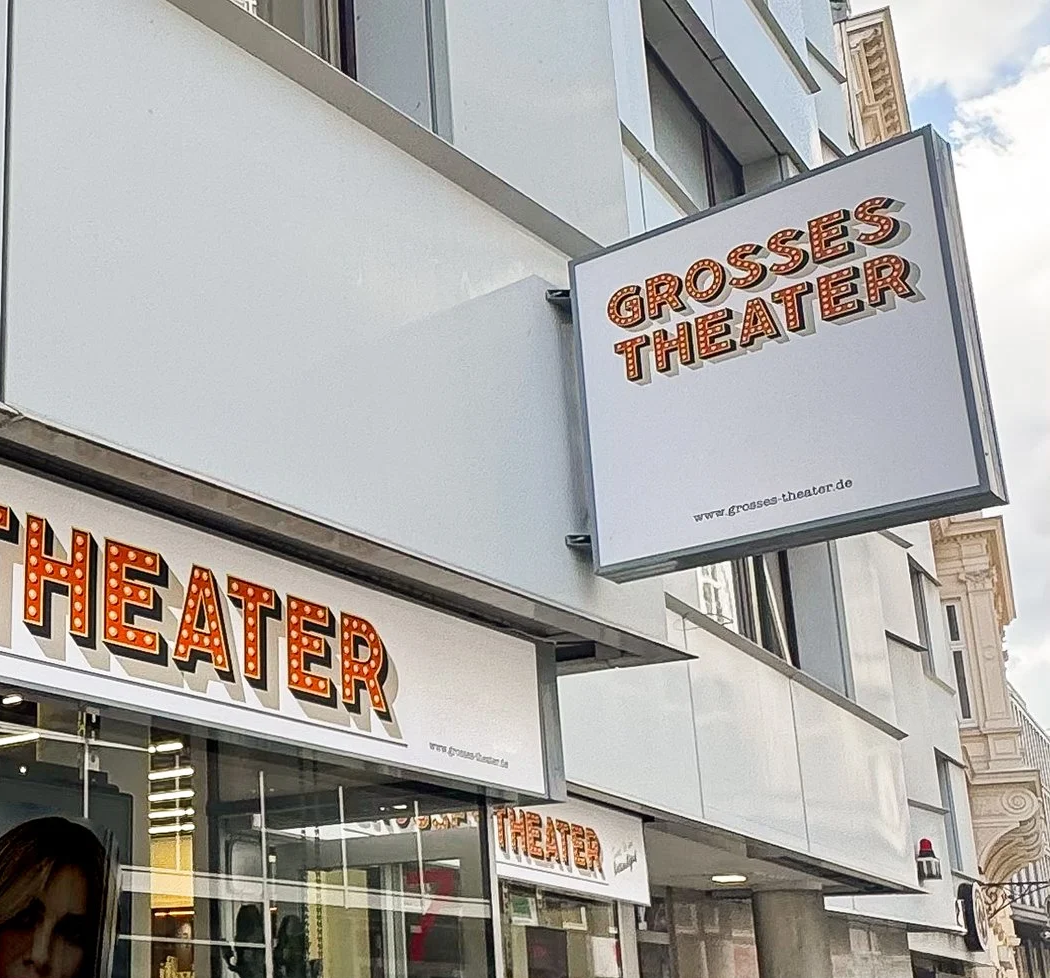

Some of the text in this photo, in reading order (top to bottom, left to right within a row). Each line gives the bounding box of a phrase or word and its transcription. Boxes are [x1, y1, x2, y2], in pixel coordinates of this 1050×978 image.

[606, 197, 900, 328] GROSSES
[613, 254, 917, 382] THEATER
[692, 478, 853, 523] www.grosses-theater.de
[492, 806, 603, 873] THEATER
